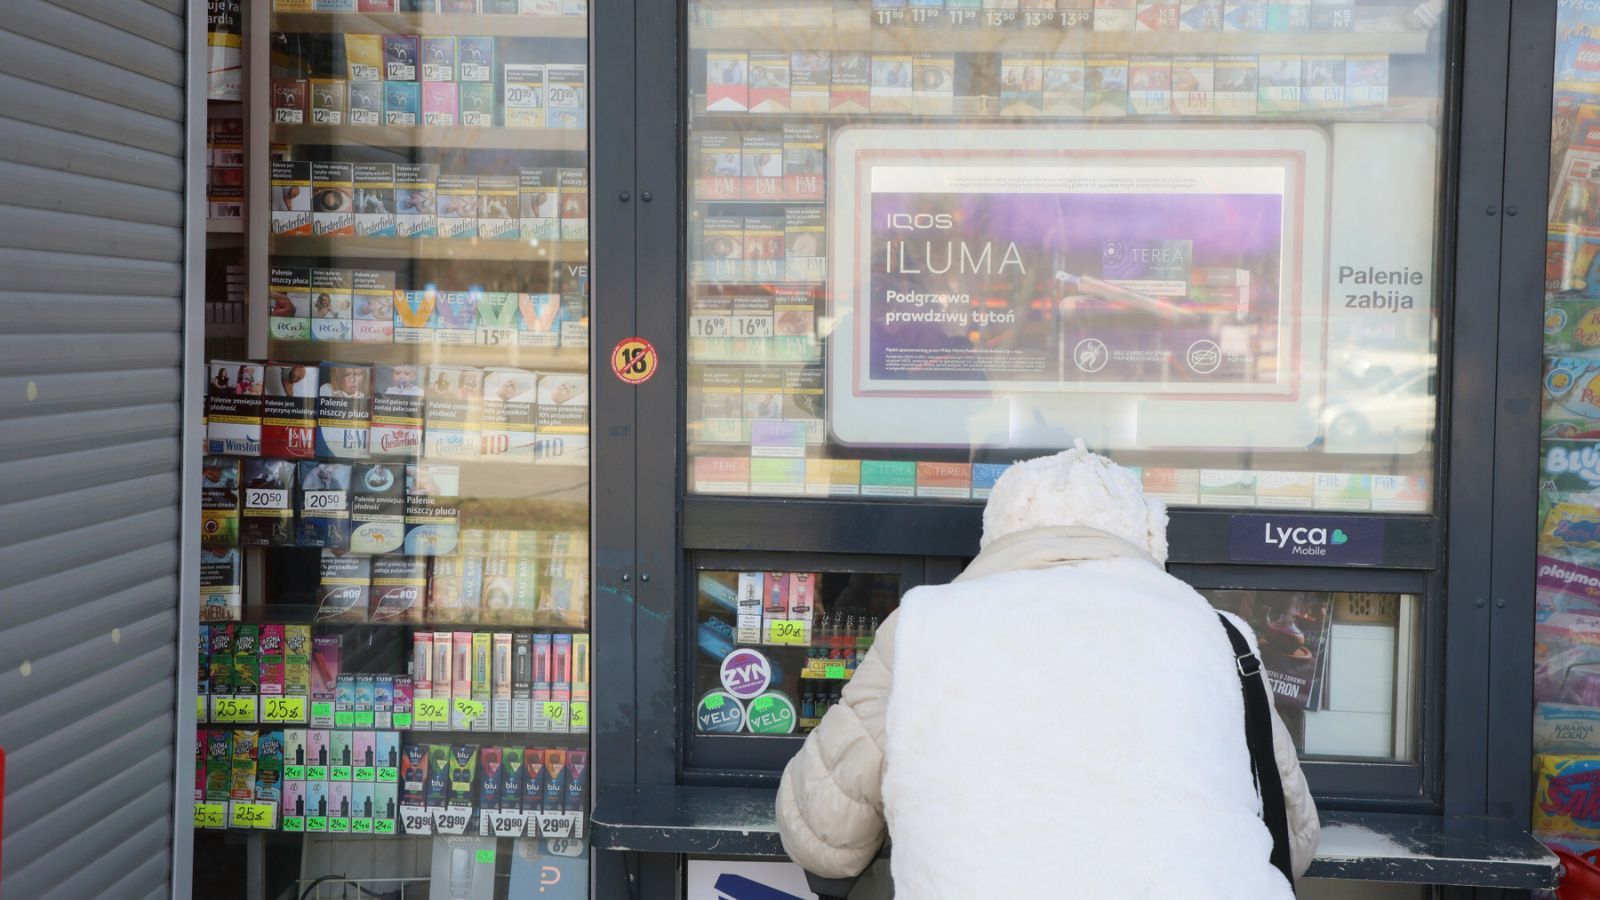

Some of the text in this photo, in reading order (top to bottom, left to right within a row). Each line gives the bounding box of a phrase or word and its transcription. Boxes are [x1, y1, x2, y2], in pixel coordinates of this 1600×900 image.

[887, 213, 952, 230] IQOS
[886, 241, 1026, 274] ILUMA
[1131, 248, 1183, 263] TEREA
[1339, 266, 1424, 286] Palenie
[886, 290, 971, 308] Podgrzewa
[1344, 290, 1414, 314] zabija
[886, 309, 1015, 327] prawdziwy tytoń
[622, 348, 647, 374] 18
[320, 398, 348, 408] Palenie
[320, 407, 346, 419] niszczy
[288, 427, 313, 449] L&M
[225, 439, 260, 454] Winston
[251, 492, 282, 506] 2050
[310, 493, 340, 508] 2050
[406, 496, 436, 506] Palenie
[406, 506, 457, 518] niszczy płuca
[1264, 522, 1327, 549] Lyca
[1292, 545, 1327, 556] Mobile
[1538, 564, 1600, 587] playmo
[776, 623, 793, 637] 30
[724, 662, 770, 687] ZYN
[217, 701, 237, 717] 25
[267, 700, 288, 719] 25
[420, 703, 435, 717] 30
[700, 707, 740, 726] VELO
[751, 708, 791, 729] VELO
[409, 751, 422, 759] blu
[456, 751, 470, 760] blu
[431, 779, 445, 788] blu
[484, 781, 497, 791] blu
[505, 781, 518, 789] blu
[526, 783, 540, 791] blu
[547, 783, 561, 791] blu
[568, 783, 582, 792] blu
[236, 806, 254, 821] 25
[438, 815, 466, 828] 2990
[495, 818, 522, 831] 2990
[542, 818, 570, 832] 2990
